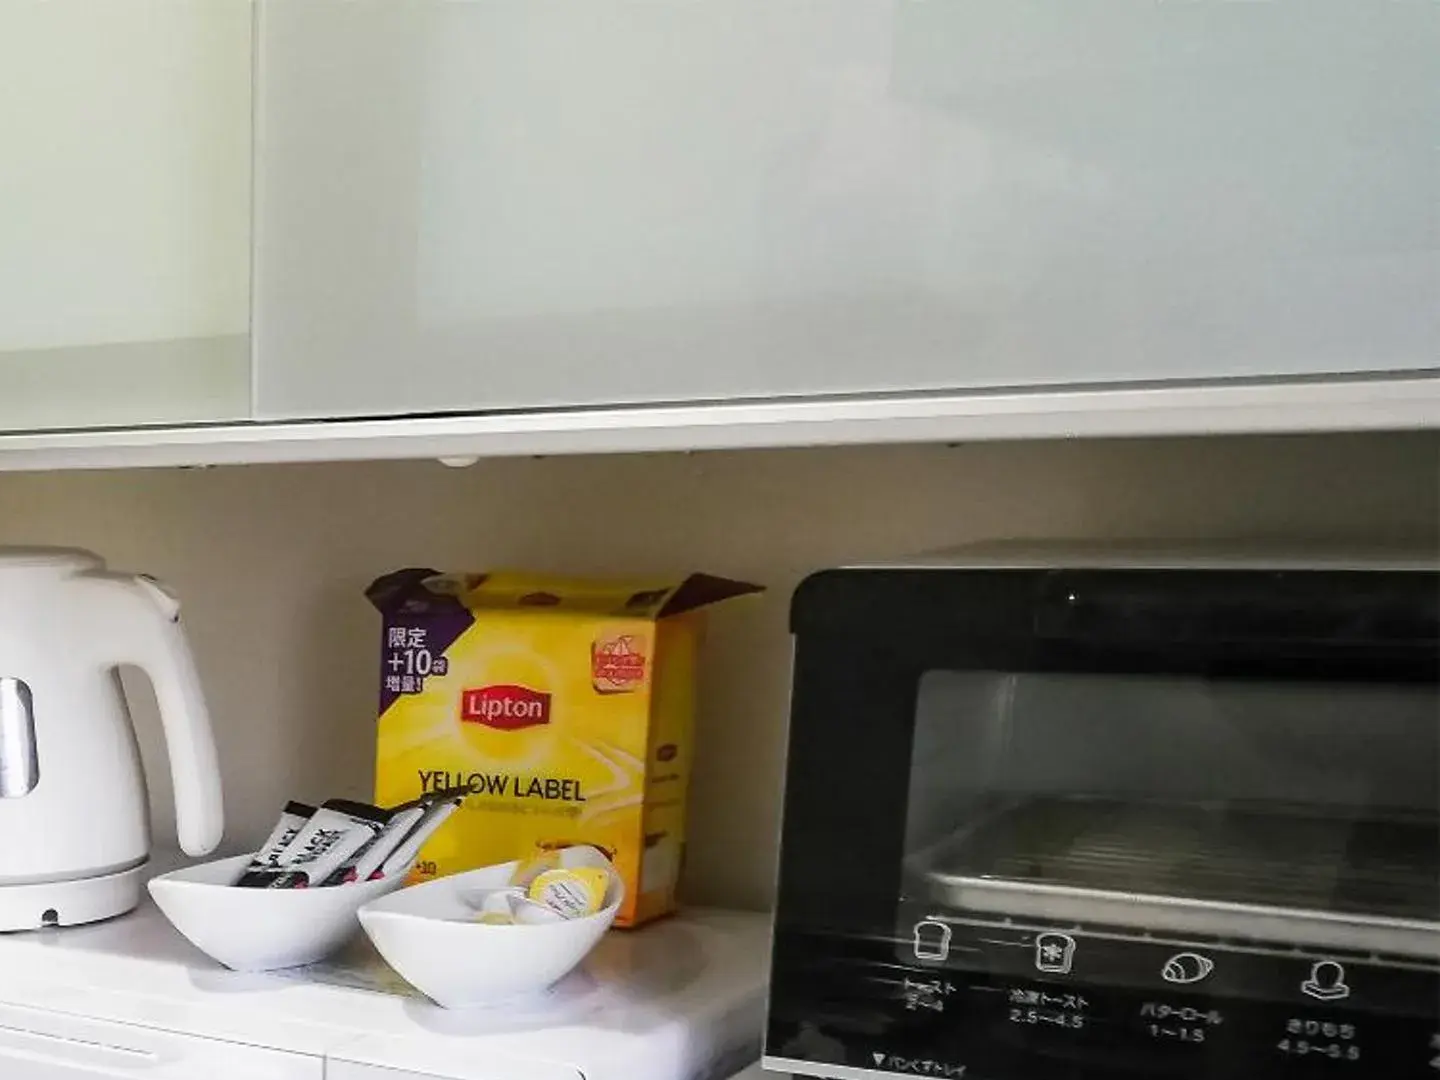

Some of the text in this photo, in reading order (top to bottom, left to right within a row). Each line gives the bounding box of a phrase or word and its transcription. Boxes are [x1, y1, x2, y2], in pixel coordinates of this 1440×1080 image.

[387, 627, 427, 648] 限定
[468, 693, 543, 721] Lipton
[418, 769, 587, 801] YELLOW LABEL
